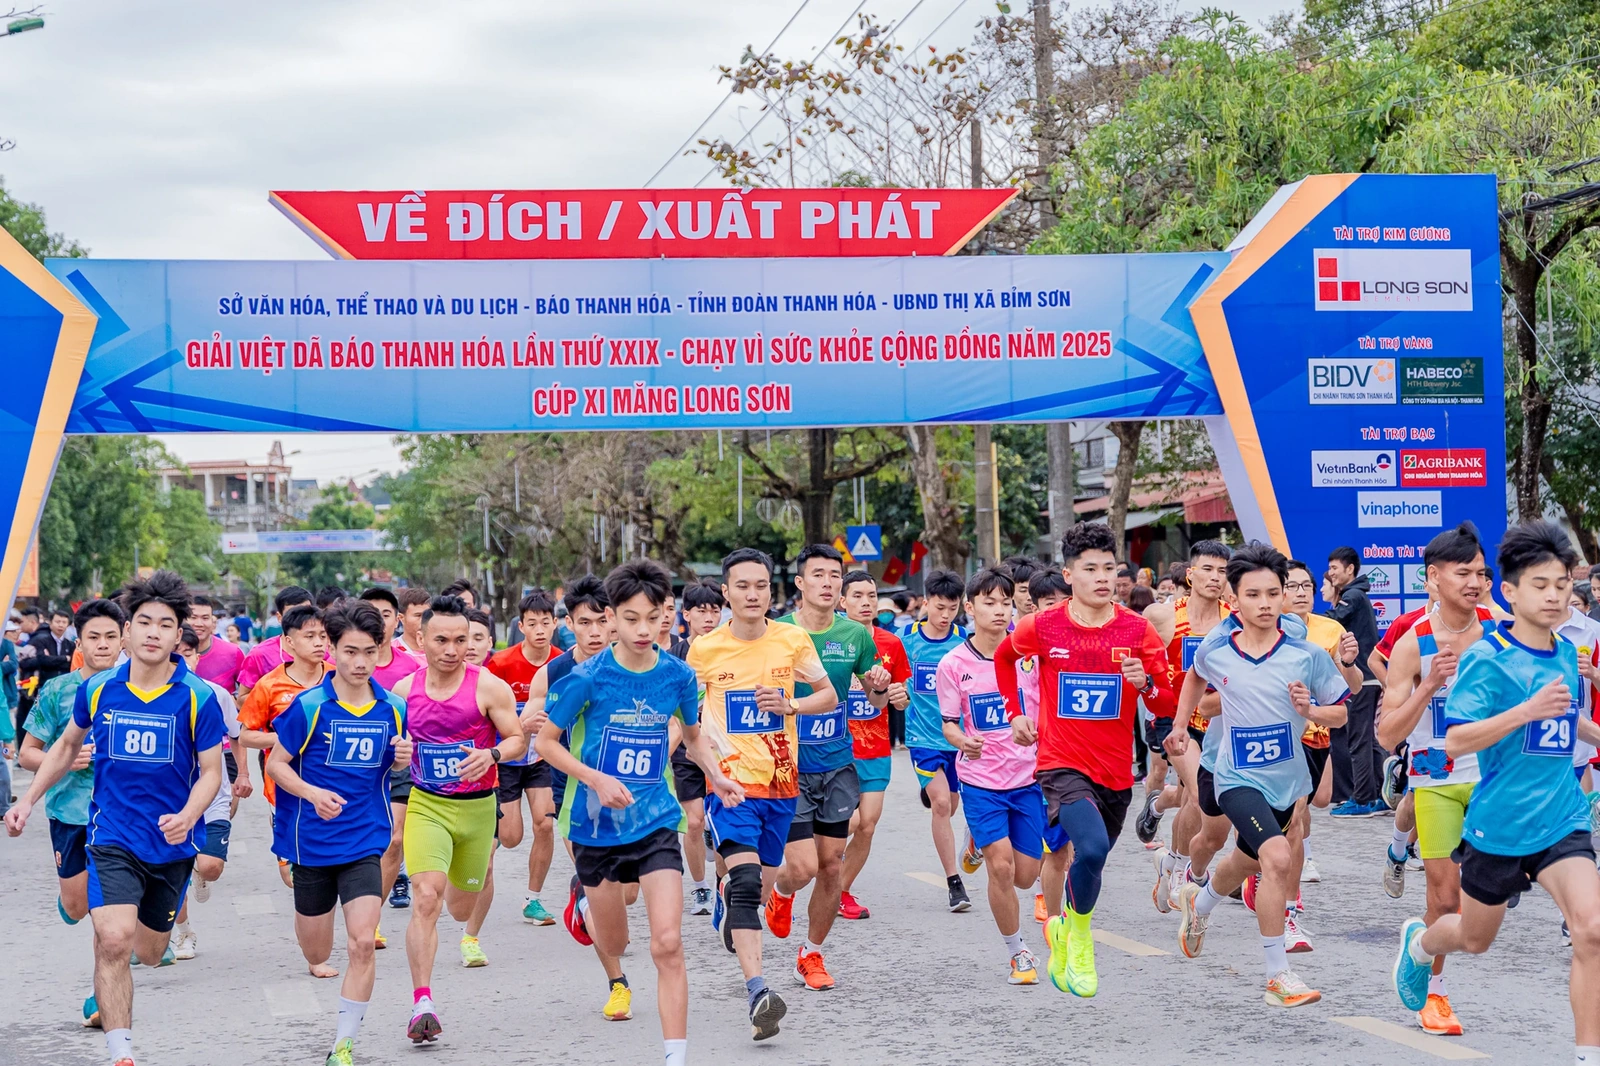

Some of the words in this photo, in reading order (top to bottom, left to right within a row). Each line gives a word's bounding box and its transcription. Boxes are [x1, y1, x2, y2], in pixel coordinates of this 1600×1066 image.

[358, 189, 428, 242] VỀ
[446, 194, 581, 240] ĐÍCH
[598, 201, 623, 240] /
[637, 186, 782, 240] XUẤT
[801, 193, 940, 238] PHÁT
[1335, 226, 1353, 240] TÀI
[1357, 226, 1379, 242] TRỢ
[1384, 229, 1405, 240] KIM
[1410, 228, 1450, 240] CƯƠNG
[1363, 282, 1419, 293] LONG
[1425, 282, 1468, 294] SON
[220, 292, 243, 314] SỞ
[249, 295, 283, 314] VĂN
[291, 295, 330, 317] HÓA,
[337, 292, 368, 315] THỂ
[374, 299, 417, 315] THAO
[424, 295, 445, 314] VÀ
[452, 299, 473, 314] DU
[481, 299, 517, 318] LỊCH
[537, 298, 569, 314] BÁO
[576, 298, 631, 314] THANH
[638, 294, 671, 313] HÓA
[689, 292, 726, 312] TỈNH
[732, 296, 777, 312] ĐOÀN
[783, 296, 837, 311] THANH
[844, 295, 876, 310] HÓA
[894, 294, 937, 310] UBND
[944, 293, 968, 312] THỊ
[975, 290, 995, 308] XÃ
[1001, 287, 1031, 307] BỈM
[1038, 290, 1070, 307] SƠN
[187, 331, 231, 367] GIẢI
[240, 336, 285, 373] VIỆT
[294, 337, 323, 367] DÃ
[331, 337, 374, 368] BÁO
[382, 342, 454, 367] THANH
[462, 336, 505, 367] HÓA
[513, 336, 554, 366] LẦN
[562, 336, 604, 365] THỨ
[610, 340, 658, 365] XXIX
[682, 339, 736, 370] CHẠY
[744, 334, 762, 363] VÌ
[771, 336, 812, 363] SỨC
[820, 329, 873, 362] KHỎE
[882, 331, 937, 366] CỘNG
[944, 329, 1000, 359] ĐỒNG
[1008, 329, 1055, 358] NĂM
[1063, 332, 1110, 356] 2025
[1358, 336, 1376, 349] TÀI
[1380, 337, 1400, 351] TRỢ
[1404, 336, 1433, 349] VÀNG
[1313, 365, 1373, 387] BIDV
[1407, 367, 1462, 379] HABECO
[534, 384, 576, 415] CÚP
[585, 389, 605, 414] XI
[613, 384, 677, 413] MĂNG
[685, 387, 739, 412] LONG
[748, 384, 790, 411] SƠN
[1361, 426, 1380, 440] TÀI
[1384, 428, 1407, 441] TRỢ
[1411, 428, 1435, 441] BẠC
[1417, 458, 1482, 468] AGRIBANK
[1361, 501, 1439, 517] vinaphone
[1364, 545, 1393, 558] ĐỒNG
[1397, 546, 1415, 557] TÀI
[925, 674, 936, 690] 3
[853, 701, 874, 716] 35
[1072, 690, 1108, 713] 37
[741, 706, 770, 727] 44
[811, 718, 836, 739] 40
[1539, 720, 1570, 748] 29
[124, 730, 156, 754] 80
[346, 738, 373, 760] 79
[1246, 739, 1280, 762] 25
[432, 757, 460, 778] 58
[617, 748, 652, 776] 66
